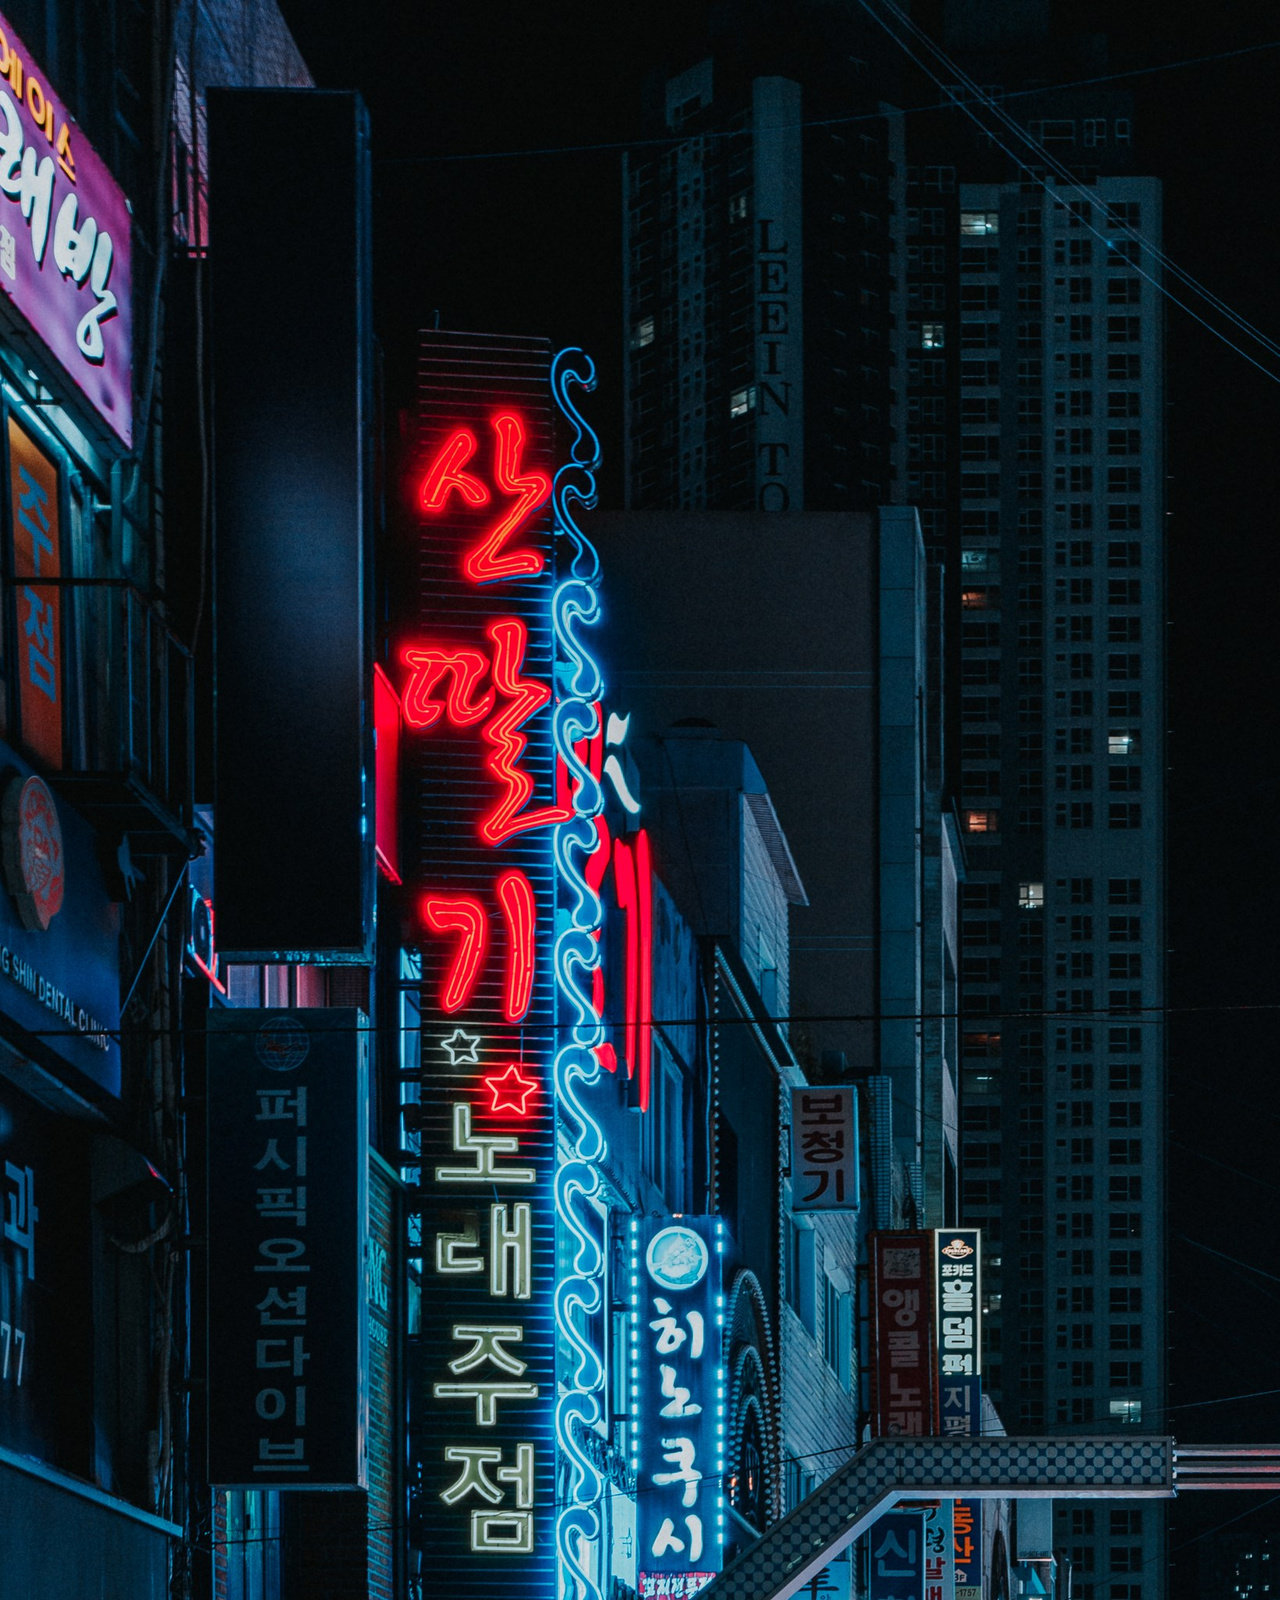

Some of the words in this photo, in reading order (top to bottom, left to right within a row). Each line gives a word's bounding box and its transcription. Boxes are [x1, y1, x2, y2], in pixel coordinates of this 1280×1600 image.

[12, 953, 37, 994] SHIN
[38, 975, 77, 1027] DENTAL
[78, 1008, 110, 1053] CLINIC
[252, 1086, 311, 1473] 퍼시픽오션다이브
[801, 1094, 845, 1203] 보청기
[433, 1101, 539, 1553] 노래주점
[648, 1297, 702, 1562] 히노쿠시
